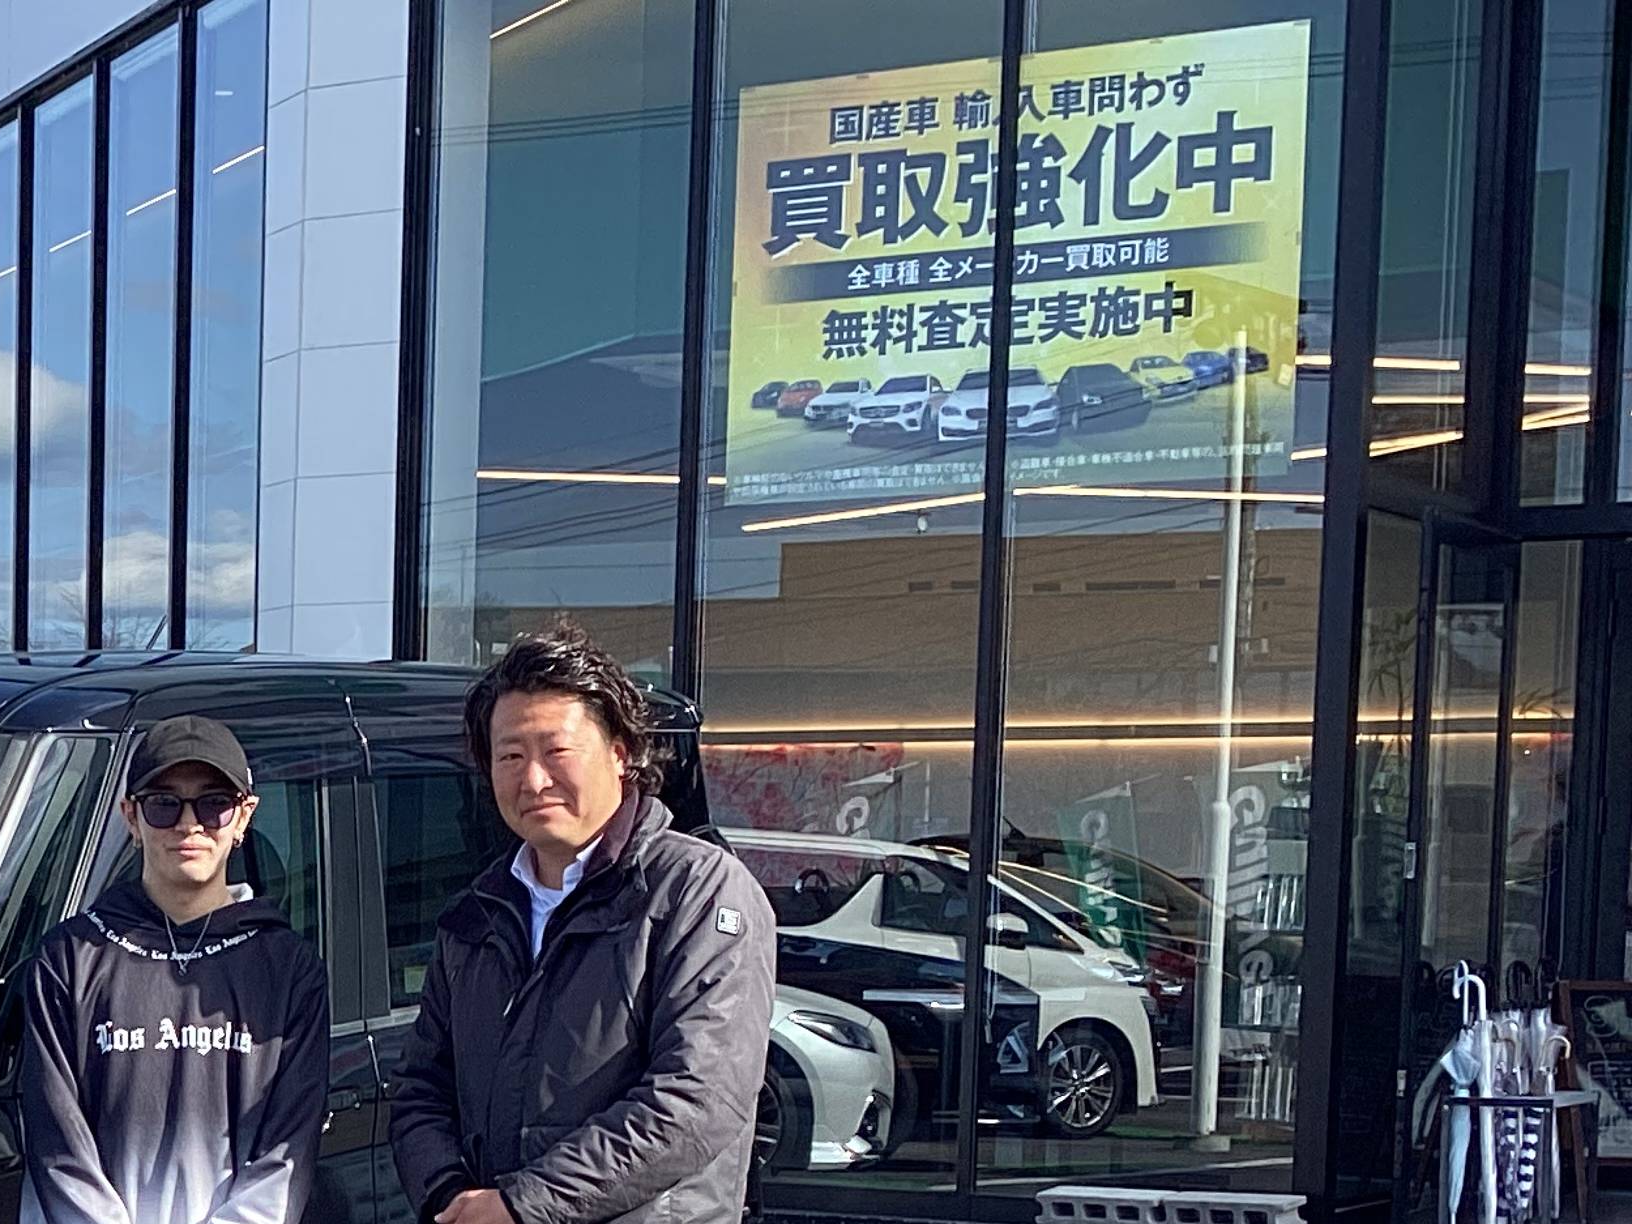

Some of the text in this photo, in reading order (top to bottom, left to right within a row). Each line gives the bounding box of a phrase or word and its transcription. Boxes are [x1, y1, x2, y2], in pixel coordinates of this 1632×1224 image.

[830, 62, 1206, 144] 国産車 輸入車問わず
[761, 110, 1274, 257] 買取強化中
[847, 237, 1170, 291] 全車種 全メーカー買取可能
[822, 280, 1193, 360] 無料査定実施中
[94, 1020, 145, 1056] Los
